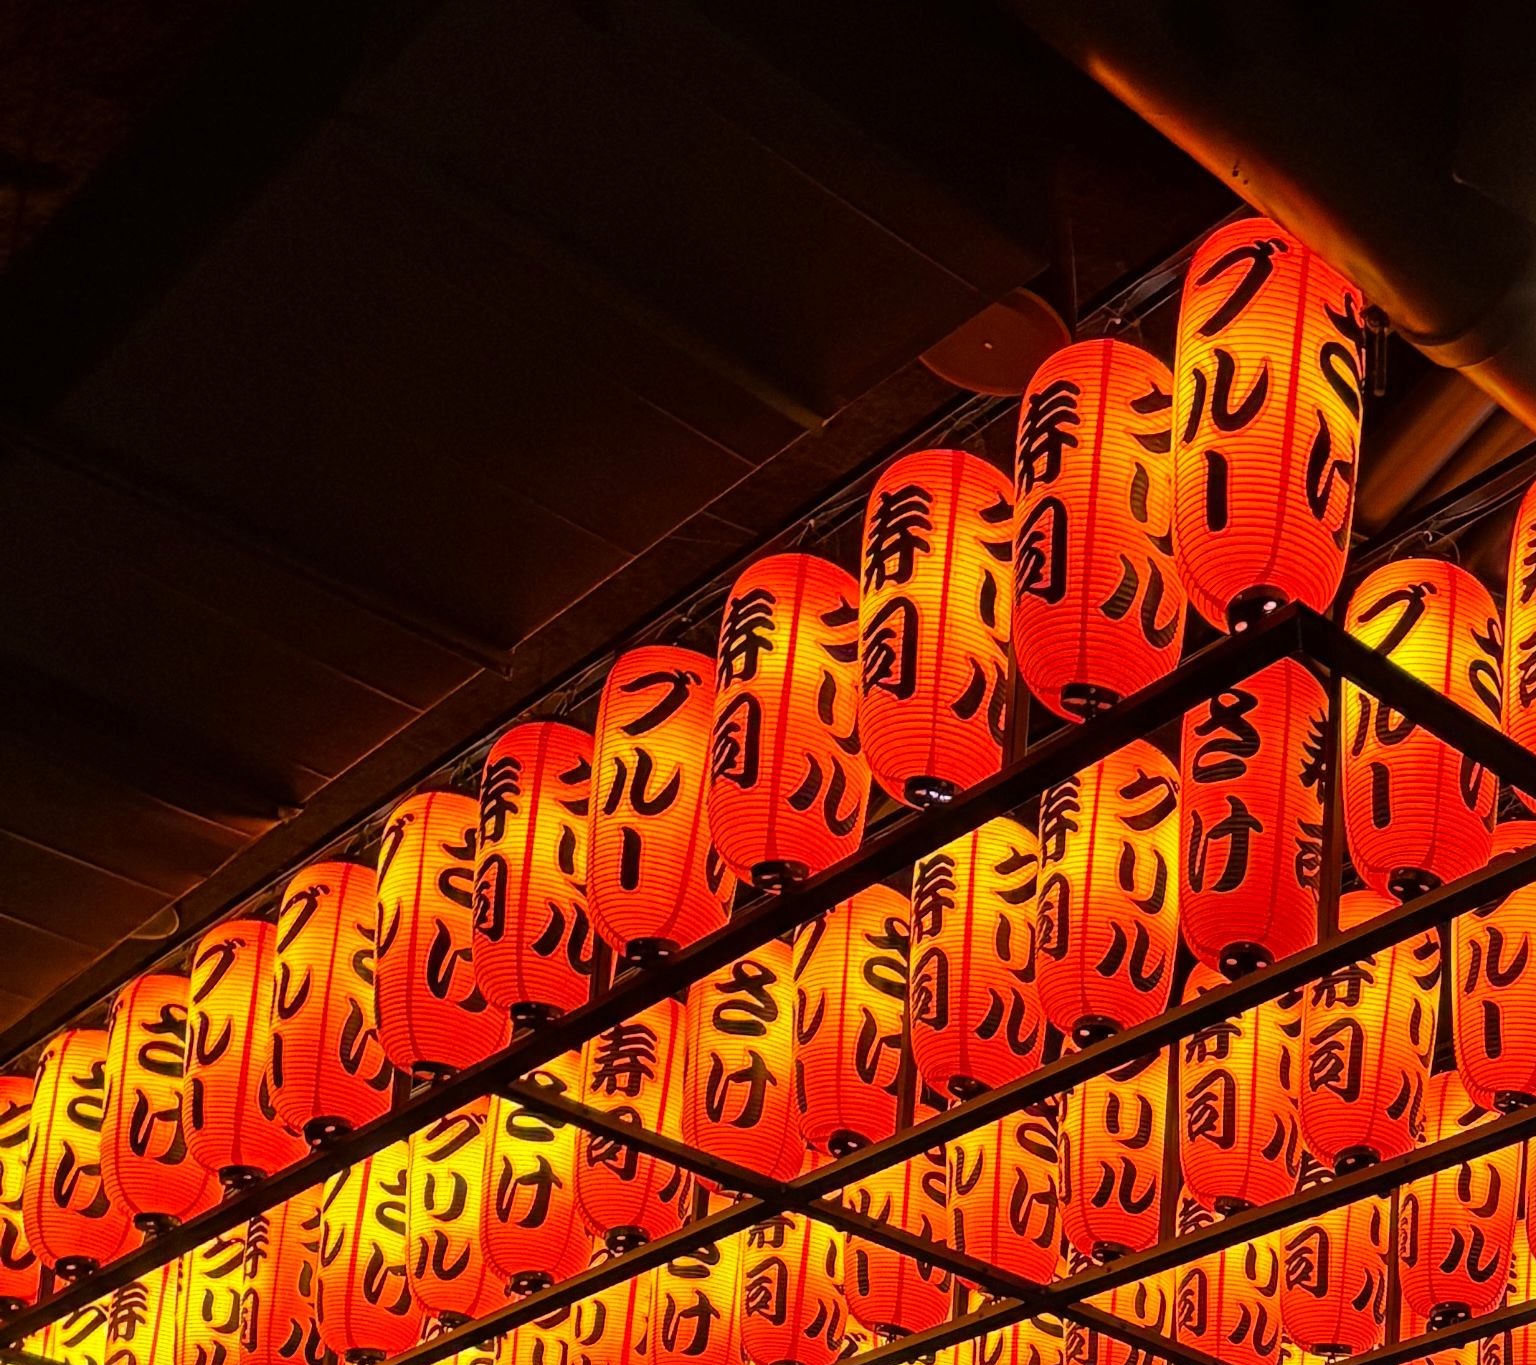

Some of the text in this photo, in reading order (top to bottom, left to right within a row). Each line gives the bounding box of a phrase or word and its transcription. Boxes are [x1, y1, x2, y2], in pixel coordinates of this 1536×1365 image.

[1183, 238, 1288, 532] ブルー
[1014, 380, 1081, 604] 寿司
[862, 484, 932, 700] 寿司
[712, 589, 776, 788] 寿司
[474, 756, 522, 941] 寿司
[603, 670, 702, 891] ブルー
[1038, 776, 1080, 960] 寿司
[1188, 691, 1264, 893] さけ
[912, 853, 955, 1031] 寿司
[1097, 768, 1180, 992] グリル
[705, 958, 778, 1128] さけ
[1466, 896, 1528, 1059] ルー
[415, 1113, 487, 1281] グリル
[1092, 1053, 1161, 1214] リル
[1440, 1162, 1501, 1283] リル
[1179, 1268, 1208, 1338] 司
[1229, 1242, 1279, 1356] リル
[1285, 1225, 1330, 1299] 司
